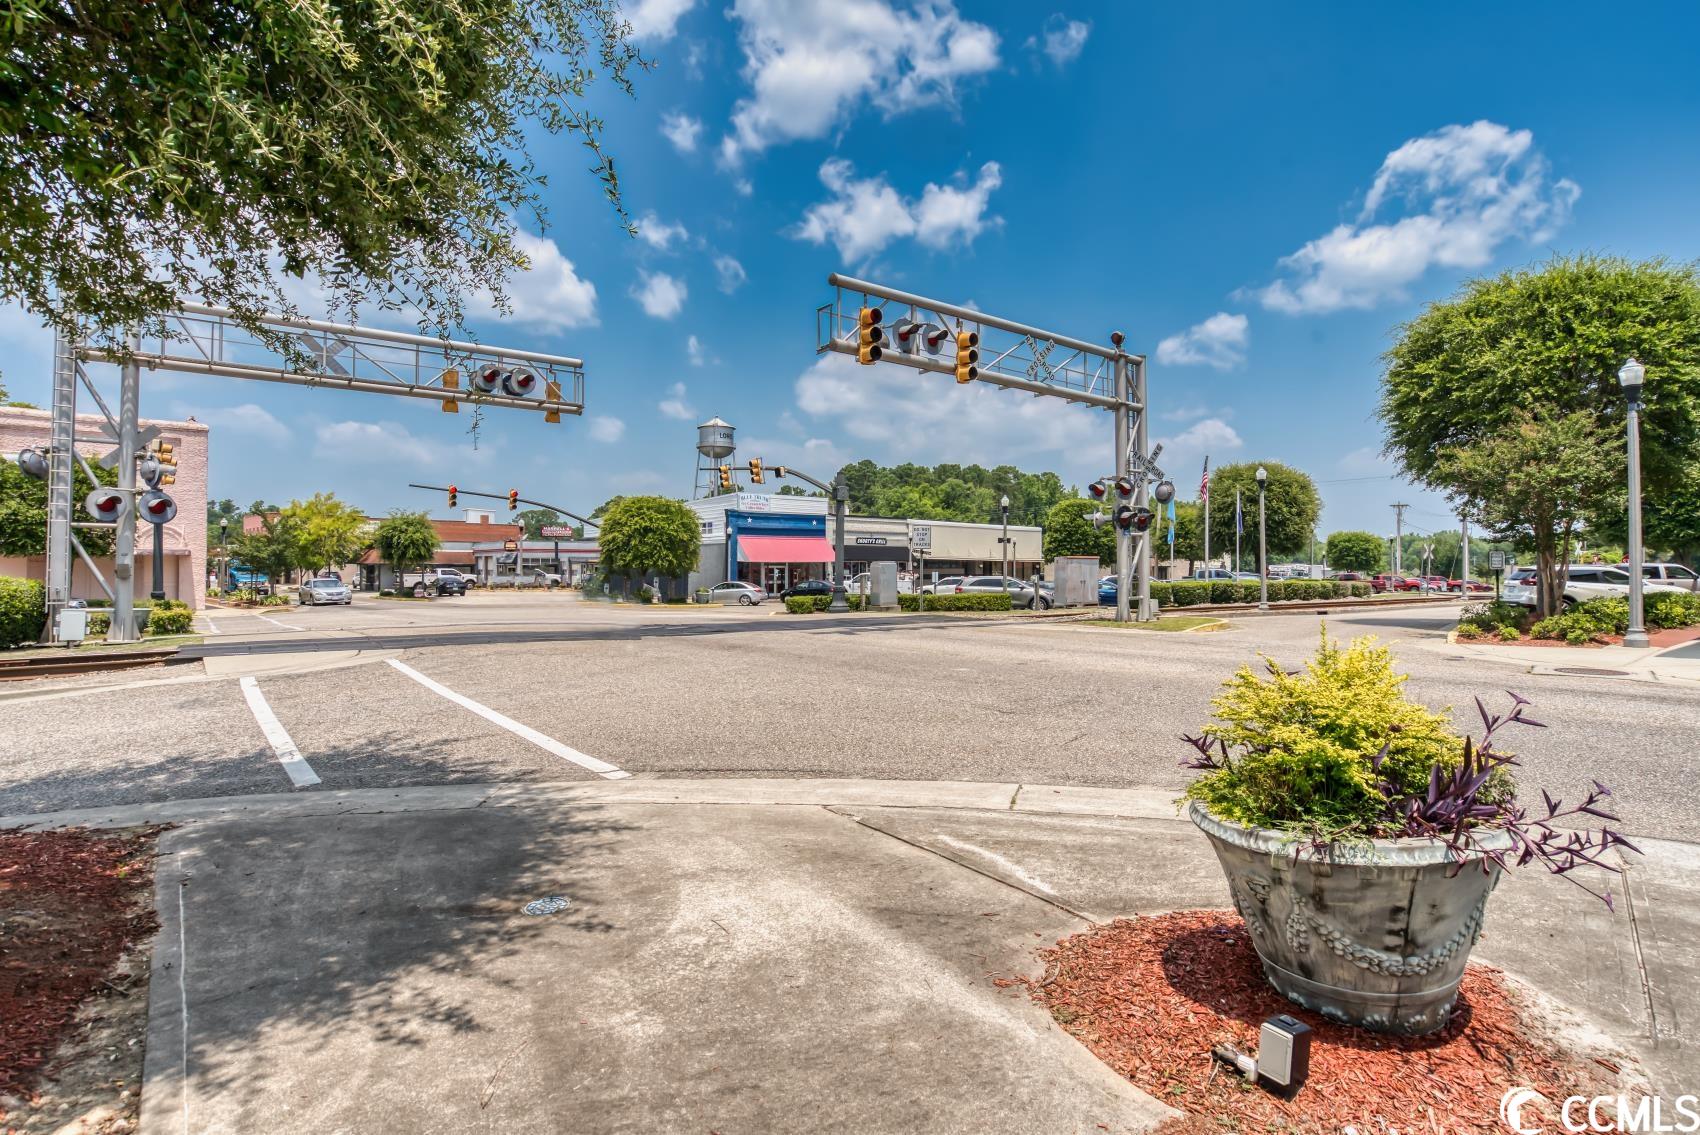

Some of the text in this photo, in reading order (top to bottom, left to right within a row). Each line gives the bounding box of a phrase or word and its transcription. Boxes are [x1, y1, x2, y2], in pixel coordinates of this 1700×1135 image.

[1026, 336, 1055, 381] RAILROAD
[1026, 341, 1055, 377] CROSSING
[1132, 451, 1165, 480] RAILROAD
[1136, 445, 1162, 488] CROSSING
